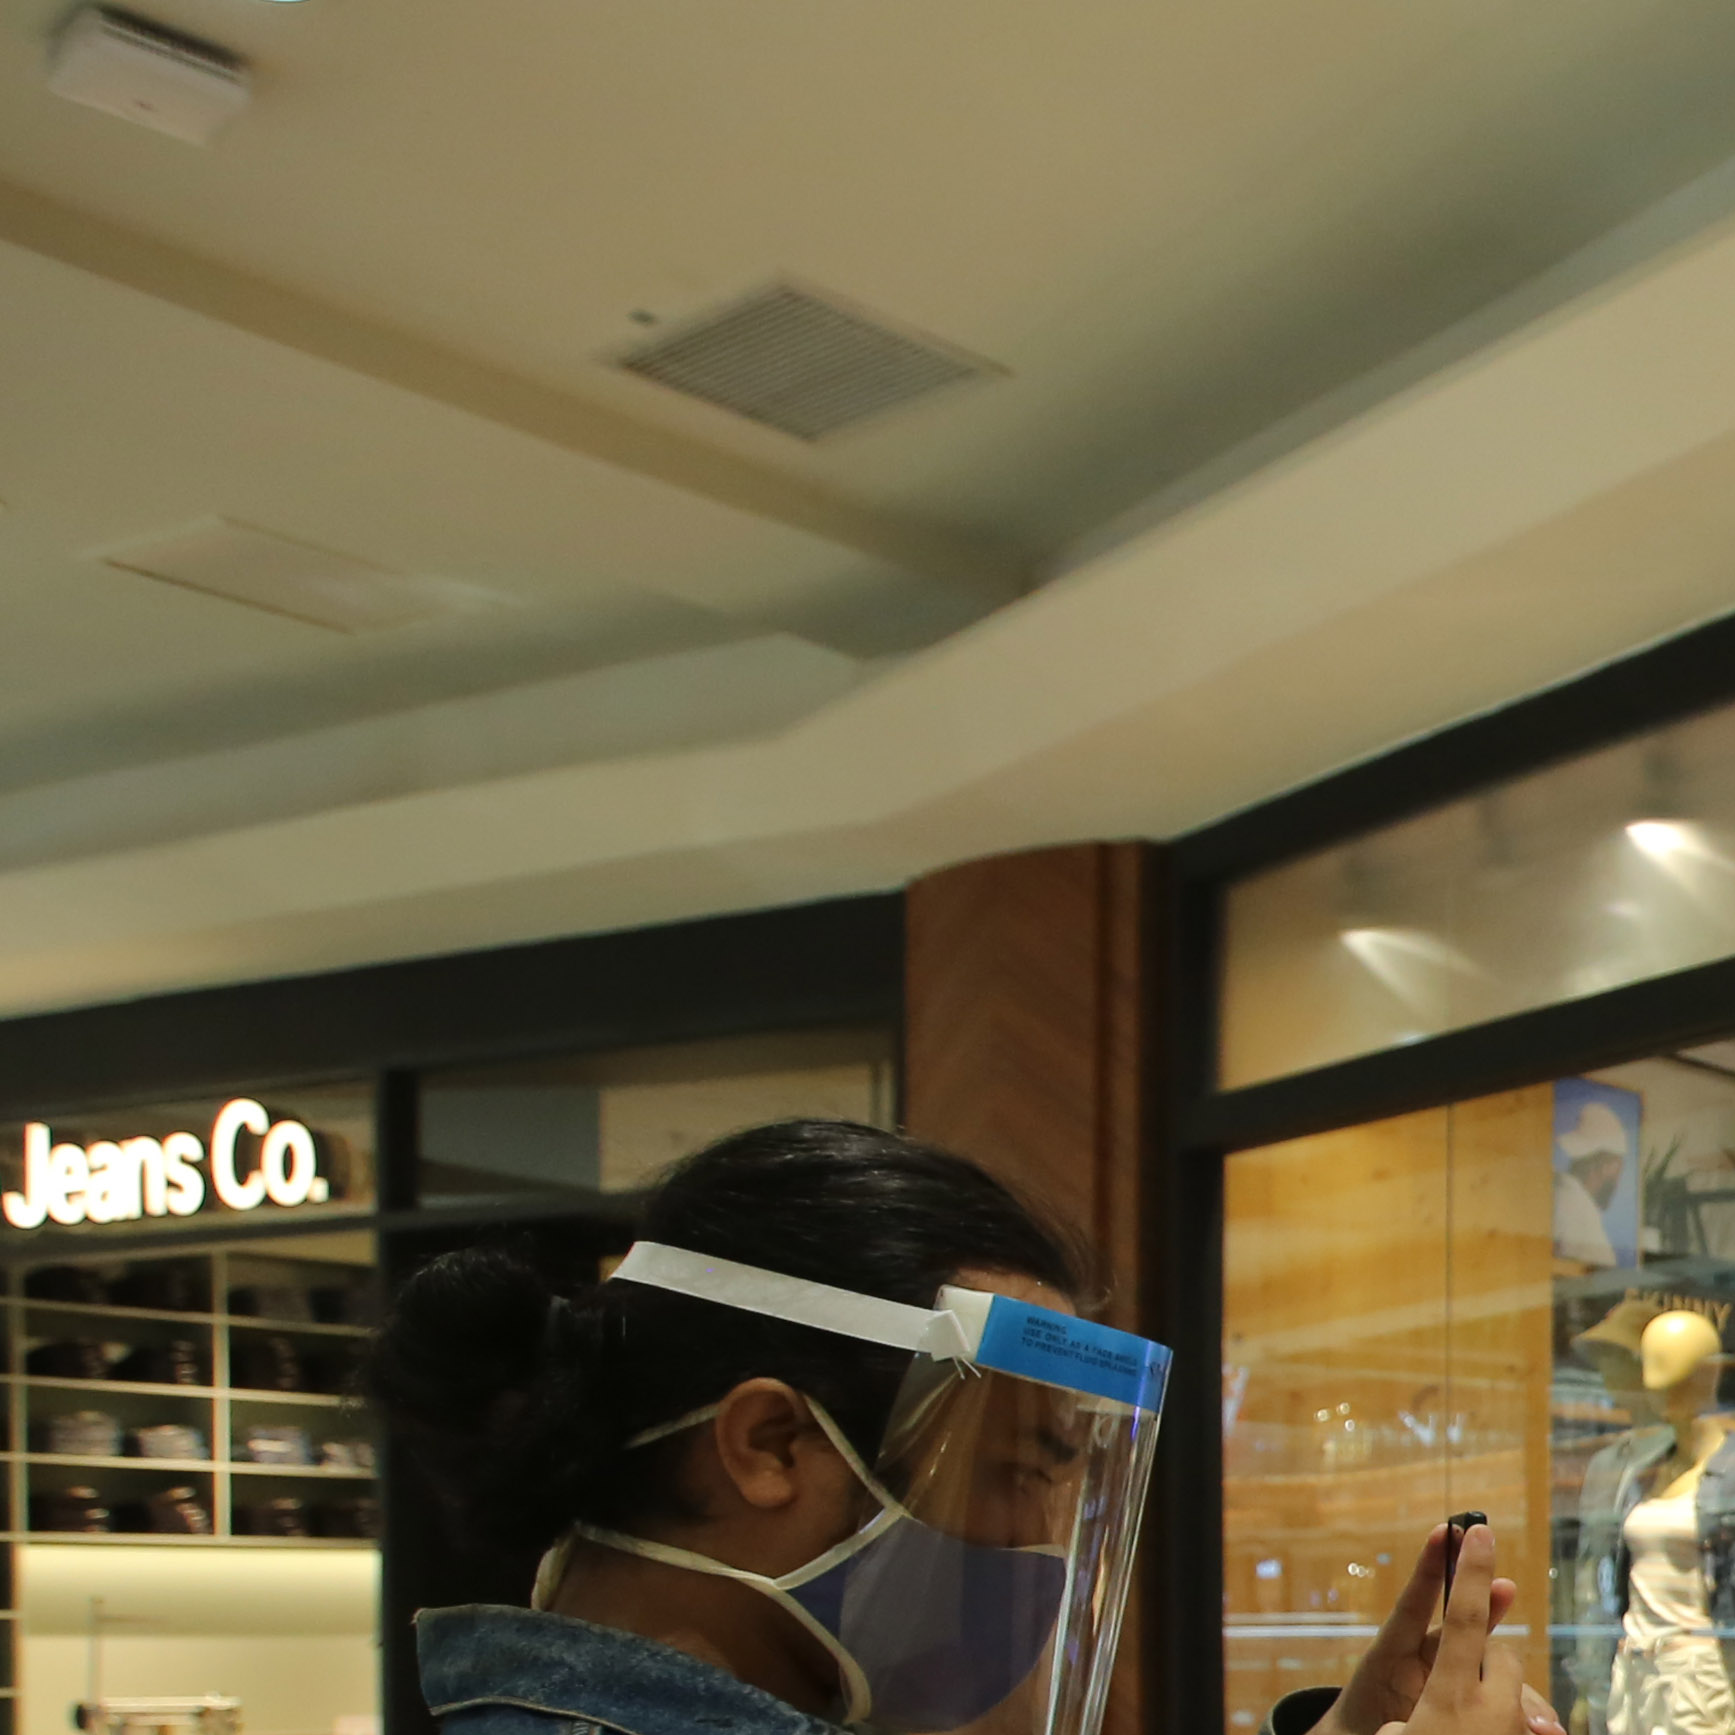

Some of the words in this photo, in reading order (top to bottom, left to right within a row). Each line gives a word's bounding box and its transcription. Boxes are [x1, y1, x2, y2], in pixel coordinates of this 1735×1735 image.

[3, 1121, 204, 1229] Jeans
[209, 1098, 329, 1211] Co.
[1027, 1316, 1067, 1334] WARNING
